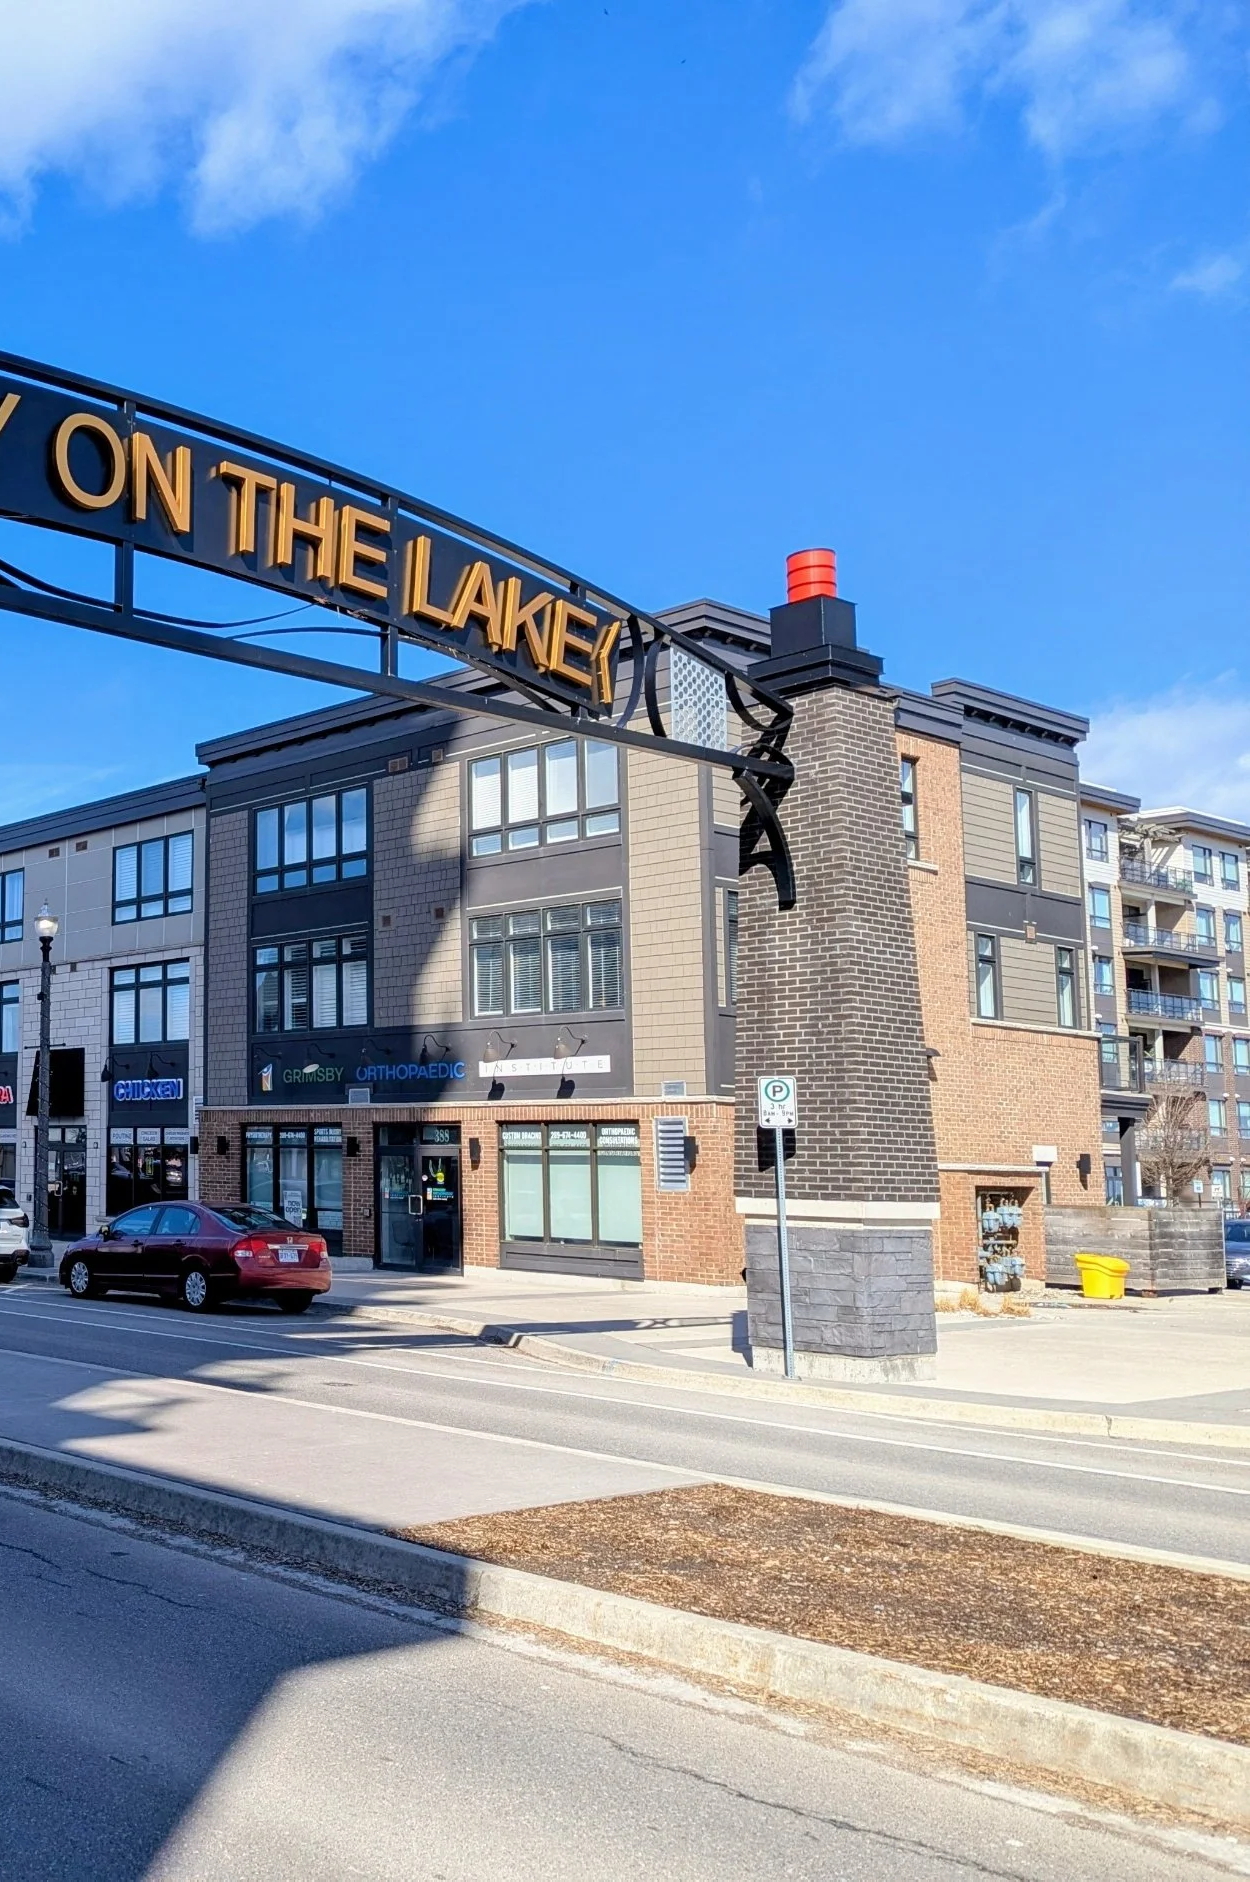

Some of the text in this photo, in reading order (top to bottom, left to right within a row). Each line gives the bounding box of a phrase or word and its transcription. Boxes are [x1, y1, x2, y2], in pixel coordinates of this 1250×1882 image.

[52, 412, 191, 534] ON
[219, 460, 391, 599] THE
[410, 535, 598, 688] LAKE
[282, 1059, 604, 1084] GRIMSBY ORTHOPAEDIC INSTITUTE
[114, 1078, 184, 1101] CHICKEN
[434, 1128, 450, 1143] 388
[502, 1131, 542, 1140] CUSTOM BRACING
[550, 1131, 587, 1140] 289-674-4400
[601, 1127, 636, 1136] ORTHOPAEDIC
[599, 1136, 638, 1145] CONSULTATIONS
[285, 1206, 302, 1215] open
